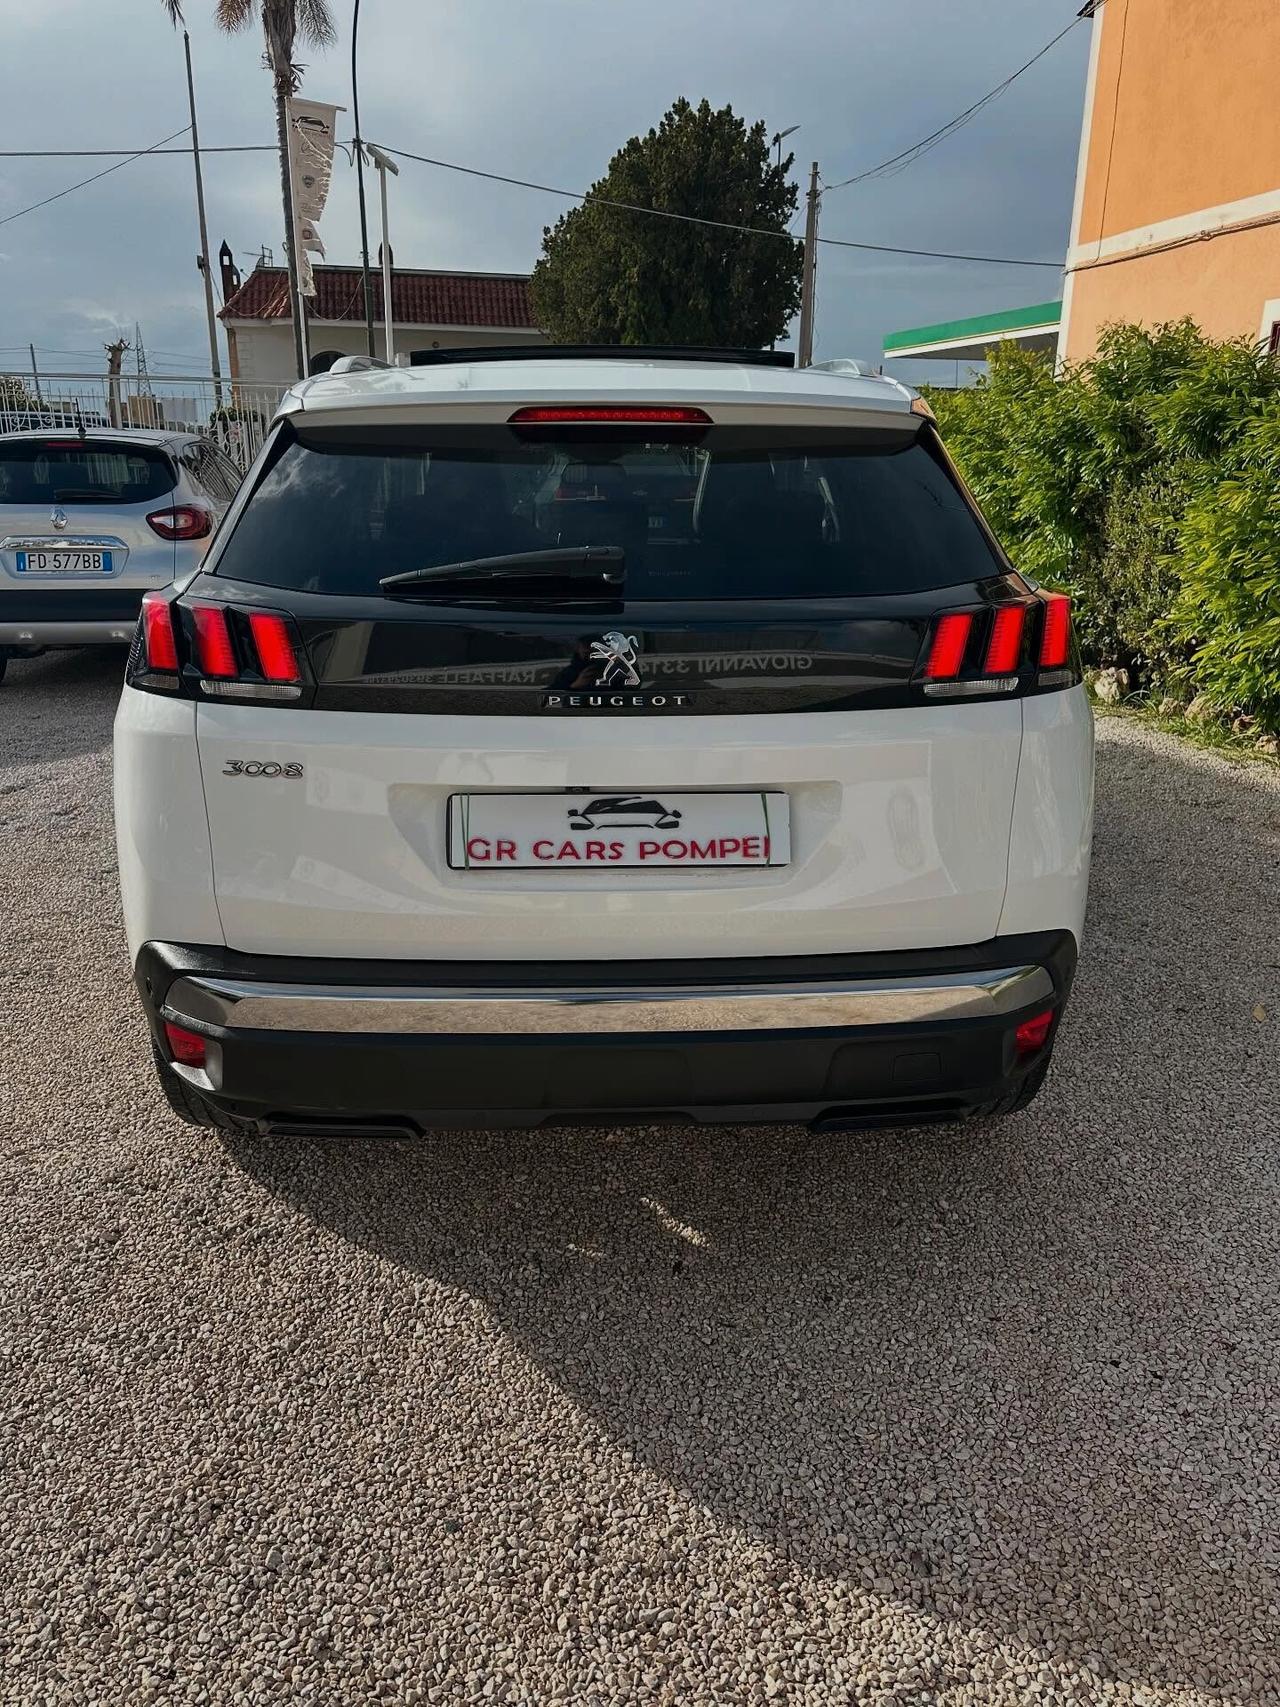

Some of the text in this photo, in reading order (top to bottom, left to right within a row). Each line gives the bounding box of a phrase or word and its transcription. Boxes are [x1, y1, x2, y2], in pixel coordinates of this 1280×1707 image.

[27, 553, 47, 569] FD
[53, 553, 102, 569] 577BB
[547, 695, 687, 706] PEUGEOT
[221, 759, 304, 780] 3008
[466, 835, 771, 862] GR CARS POMPEI
